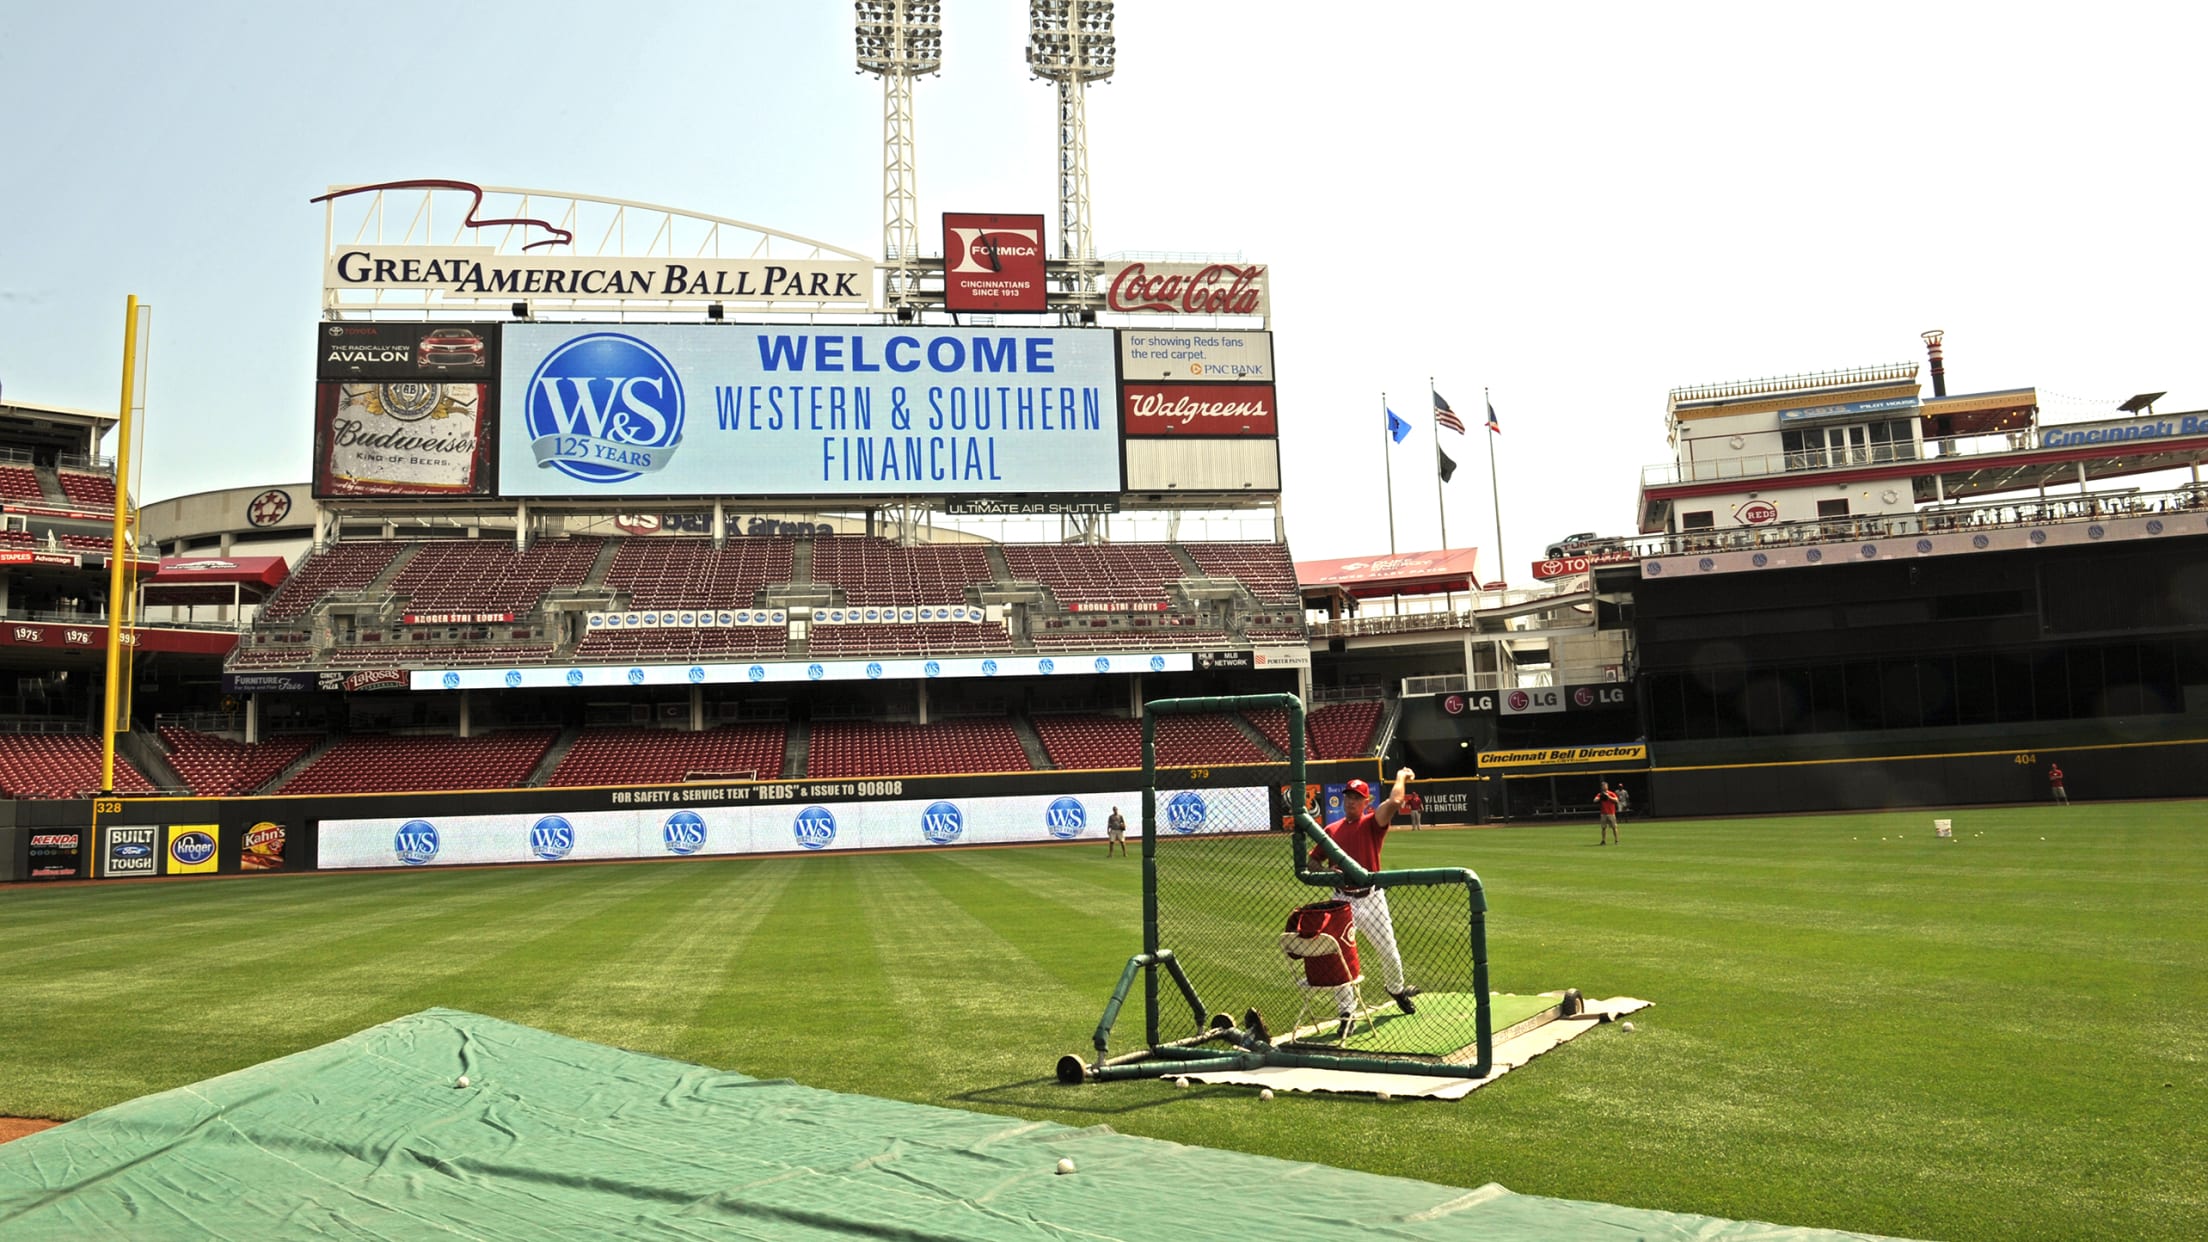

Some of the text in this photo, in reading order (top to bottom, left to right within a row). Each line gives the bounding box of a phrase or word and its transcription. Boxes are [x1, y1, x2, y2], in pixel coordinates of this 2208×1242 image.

[337, 251, 861, 298] GREAT AMERICAN BALL PARK
[961, 281, 1031, 289] CINCINNATIANS
[1108, 262, 1266, 314] Coca-Cola
[1131, 336, 1244, 348] for showing Reds fans
[328, 351, 409, 362] AVALON
[757, 335, 1055, 373] WELCOME
[1131, 349, 1206, 361] the red carpet.
[1204, 364, 1264, 375] PNC BANK
[540, 376, 666, 445] W&S
[715, 386, 1101, 431] WESTERN & SOUTHERN
[1130, 393, 1268, 424] Walgreens
[333, 418, 476, 453] Budweiser
[2044, 420, 2173, 448] Cincinnati
[356, 452, 384, 462] KING
[554, 437, 651, 467] 125 YEARS
[823, 437, 1001, 481] FINANCIAL
[949, 503, 1113, 514] ULTIMATE AIR SHUTTLE
[1747, 510, 1776, 519] REDS
[748, 517, 833, 537] arena
[0, 553, 71, 564] STAPLES Advantage
[16, 628, 38, 640] 1975
[67, 630, 88, 643] 1976
[1214, 659, 1248, 667] NETWORK
[234, 676, 278, 685] FURNITURE
[1534, 692, 1557, 707] LG
[1600, 688, 1624, 703] LG
[1469, 696, 1492, 711] LG
[1481, 751, 1546, 764] Cincinnati
[1550, 750, 1576, 760] Bell
[1579, 746, 1640, 758] Directory
[2014, 754, 2037, 765] 404
[1190, 769, 1209, 779] 379
[612, 792, 632, 803] FOR
[634, 791, 670, 802] SAFETY
[672, 791, 680, 801] &
[682, 789, 724, 801] SERVICE
[727, 788, 750, 800] TEXT
[801, 787, 808, 796] &
[810, 786, 840, 797] ISSUE
[841, 785, 855, 796] TO
[857, 781, 903, 796] 90808
[1449, 794, 1467, 802] CITY
[97, 803, 122, 813] 328
[30, 834, 78, 845] KENDA
[112, 830, 153, 844] BUILT
[245, 827, 286, 846] Kahn's
[122, 847, 140, 855] Ford
[177, 836, 212, 860] Kroger
[111, 858, 152, 870] TOUGH
